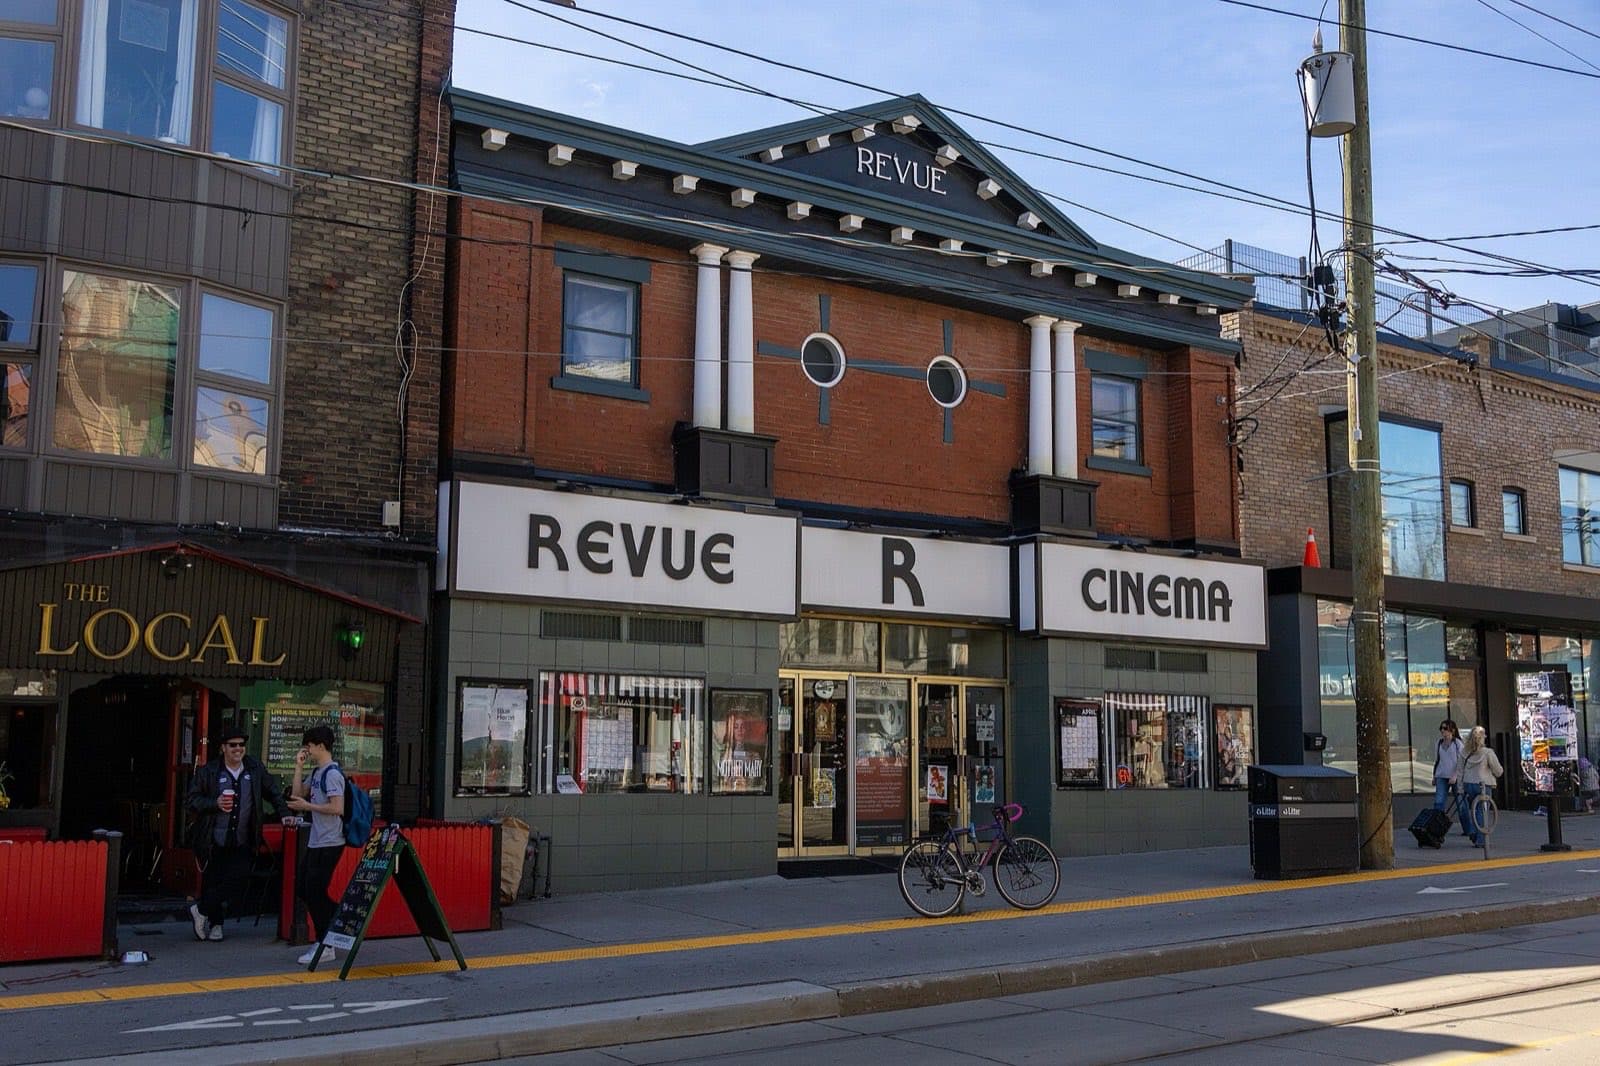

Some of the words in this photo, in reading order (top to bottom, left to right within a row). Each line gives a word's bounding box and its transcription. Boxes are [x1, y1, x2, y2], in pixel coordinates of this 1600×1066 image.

[857, 146, 947, 196] REVUE
[527, 513, 735, 584] REVUE
[881, 537, 925, 607] R
[63, 582, 110, 602] THE
[1080, 567, 1233, 622] CINEMA
[35, 602, 287, 667] LOCAL
[717, 759, 744, 777] MOTHER
[744, 759, 763, 777] MARY
[1262, 806, 1276, 816] Litter
[1288, 806, 1301, 816] Litter
